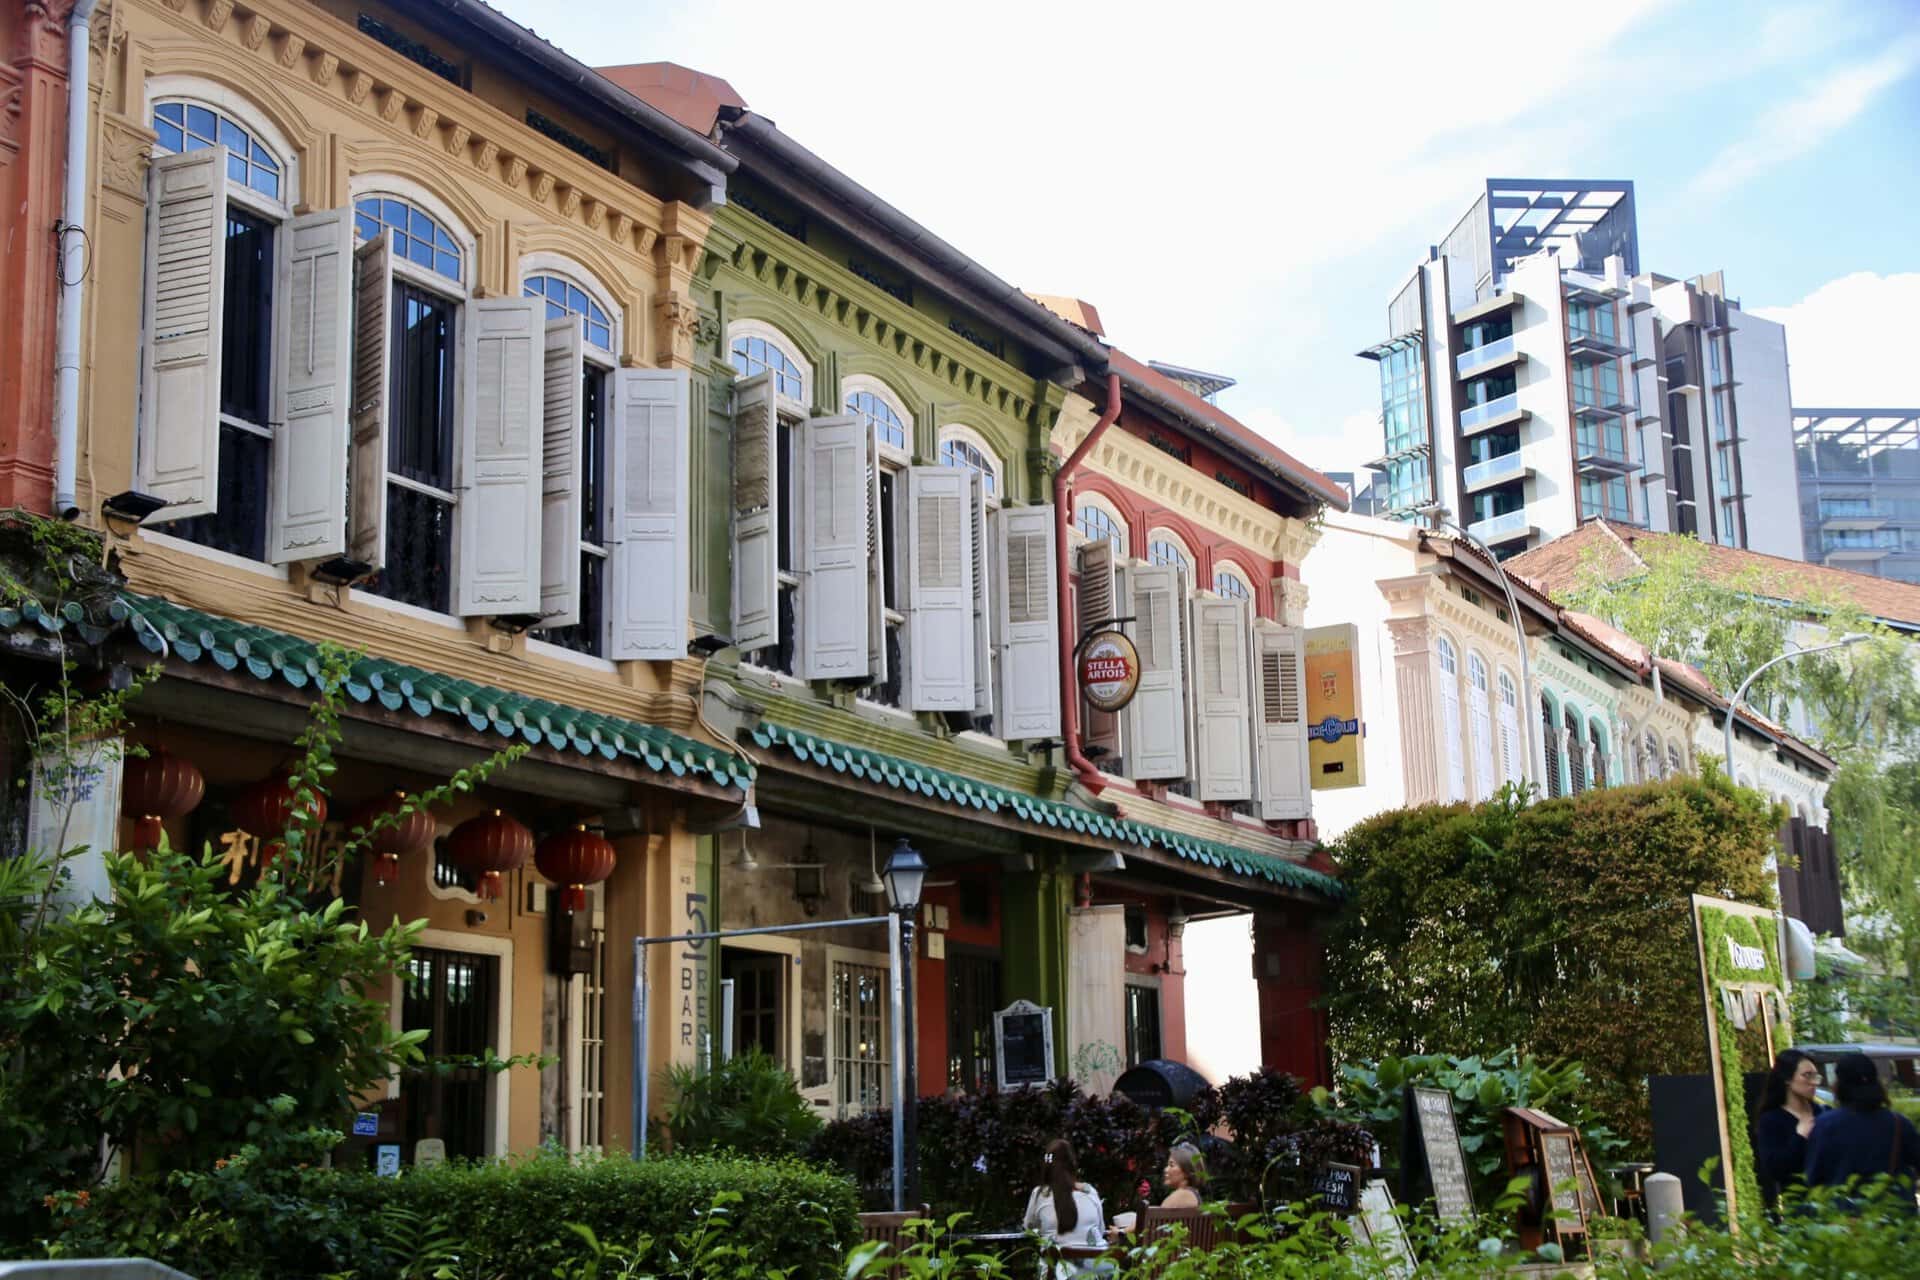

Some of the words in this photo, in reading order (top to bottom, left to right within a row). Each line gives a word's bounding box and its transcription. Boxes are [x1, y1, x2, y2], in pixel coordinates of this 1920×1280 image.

[1087, 660, 1125, 672] STELLA
[1087, 668, 1126, 680] ARTOIS
[681, 967, 693, 1046] BAR
